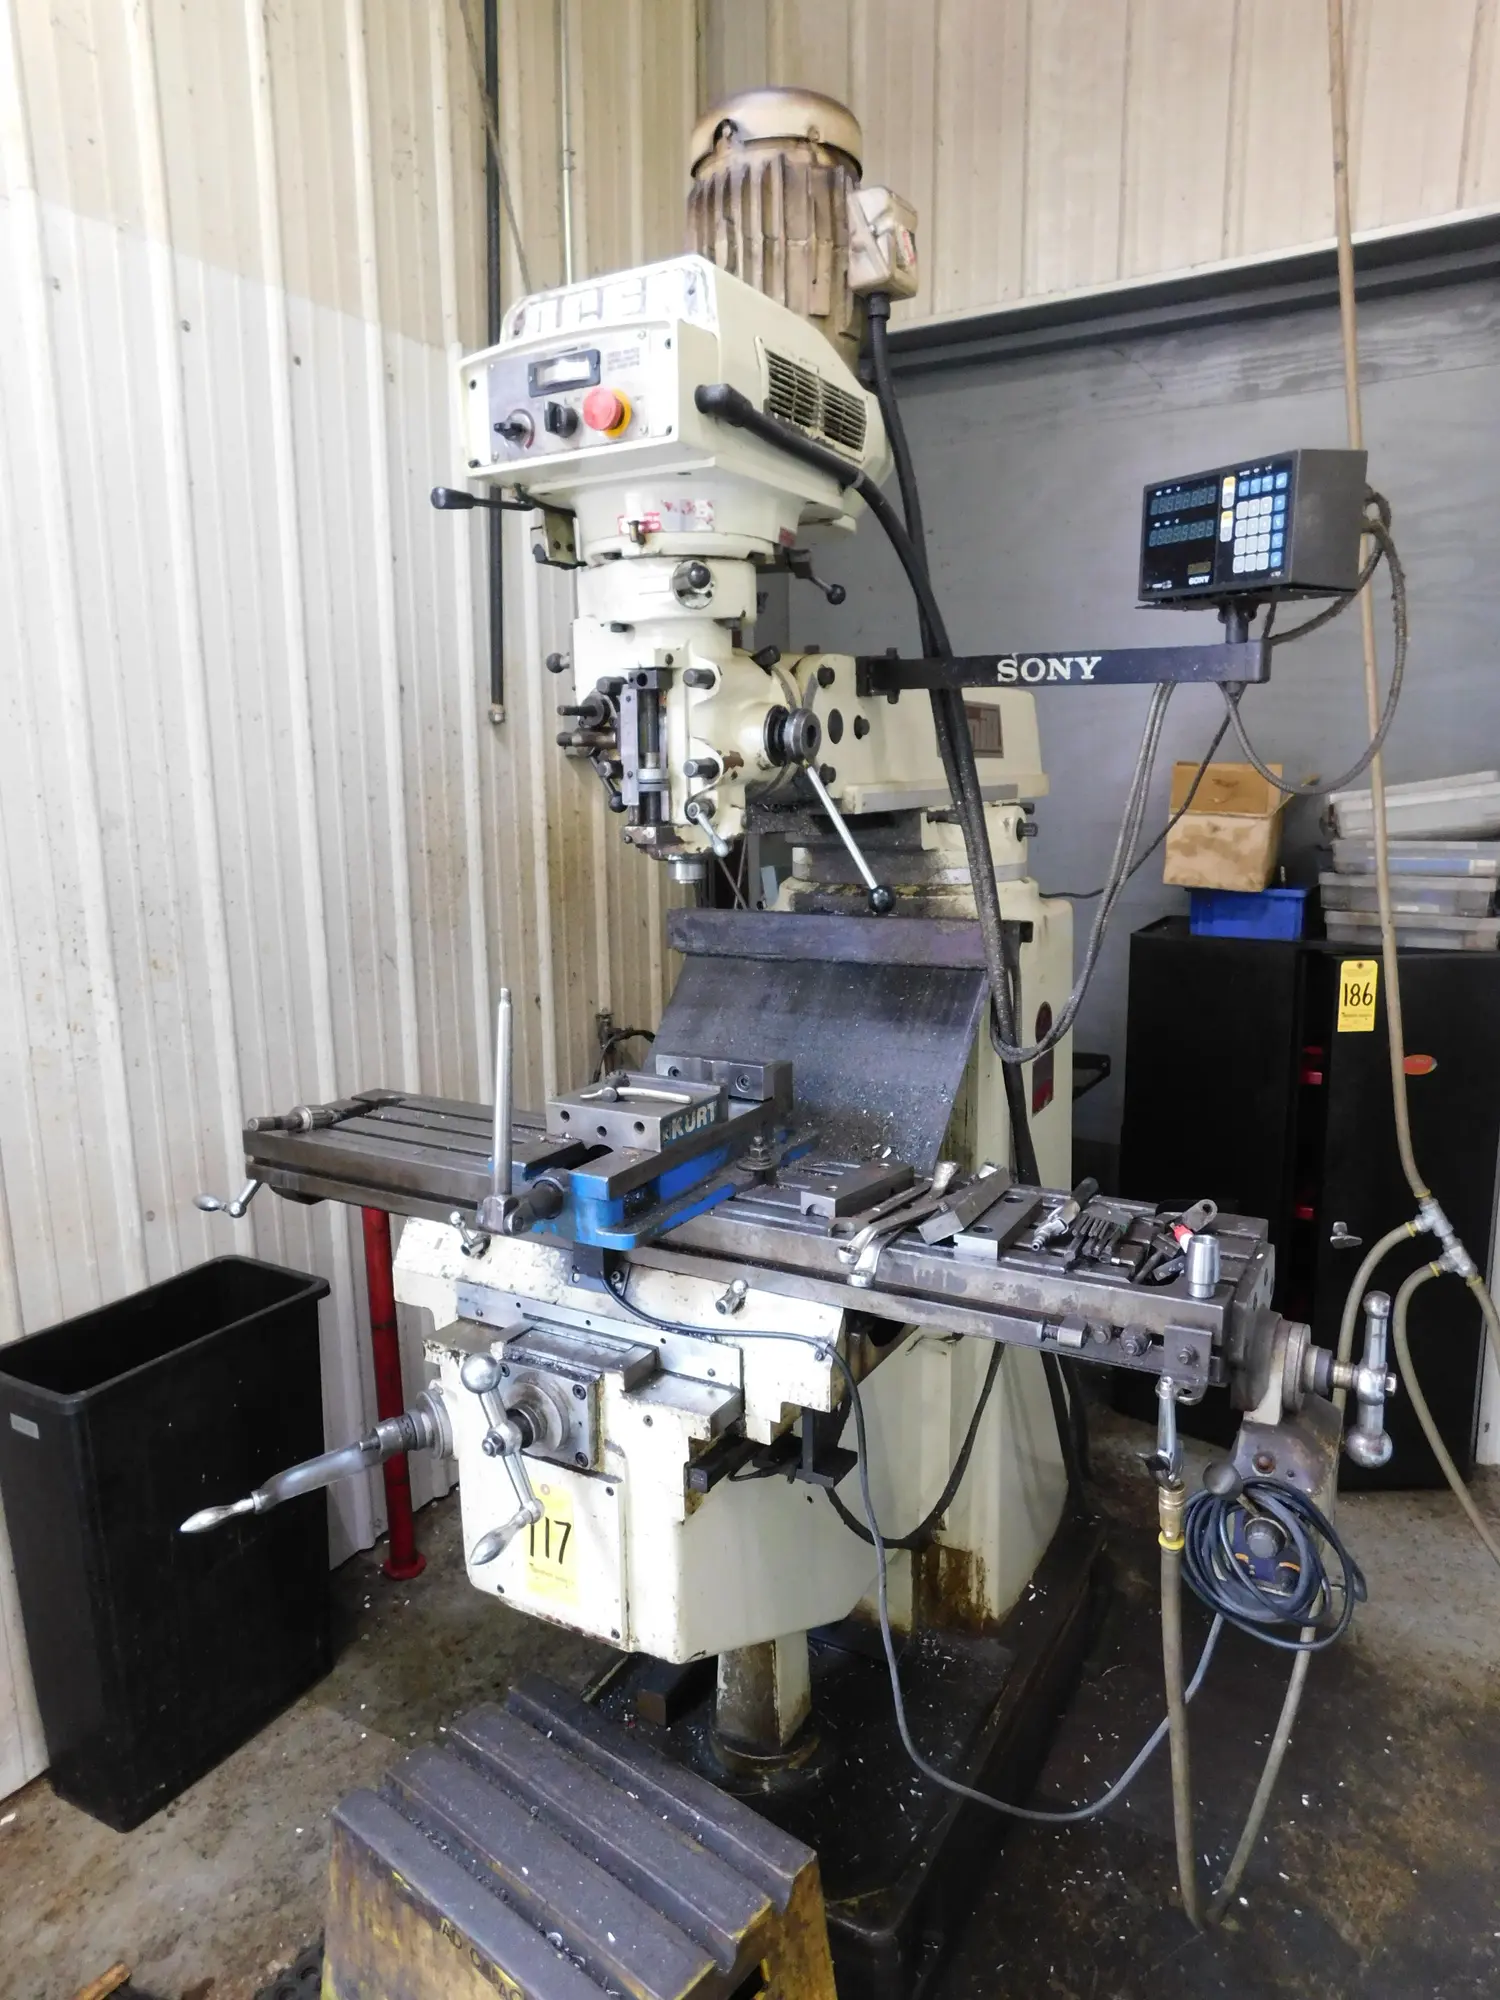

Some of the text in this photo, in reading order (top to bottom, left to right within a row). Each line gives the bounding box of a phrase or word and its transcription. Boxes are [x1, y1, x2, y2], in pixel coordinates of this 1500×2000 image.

[1188, 575, 1210, 586] SONY
[997, 655, 1102, 682] SONY
[1344, 982, 1374, 1007] 186
[671, 1100, 718, 1140] KURT
[530, 1517, 572, 1565] 117
